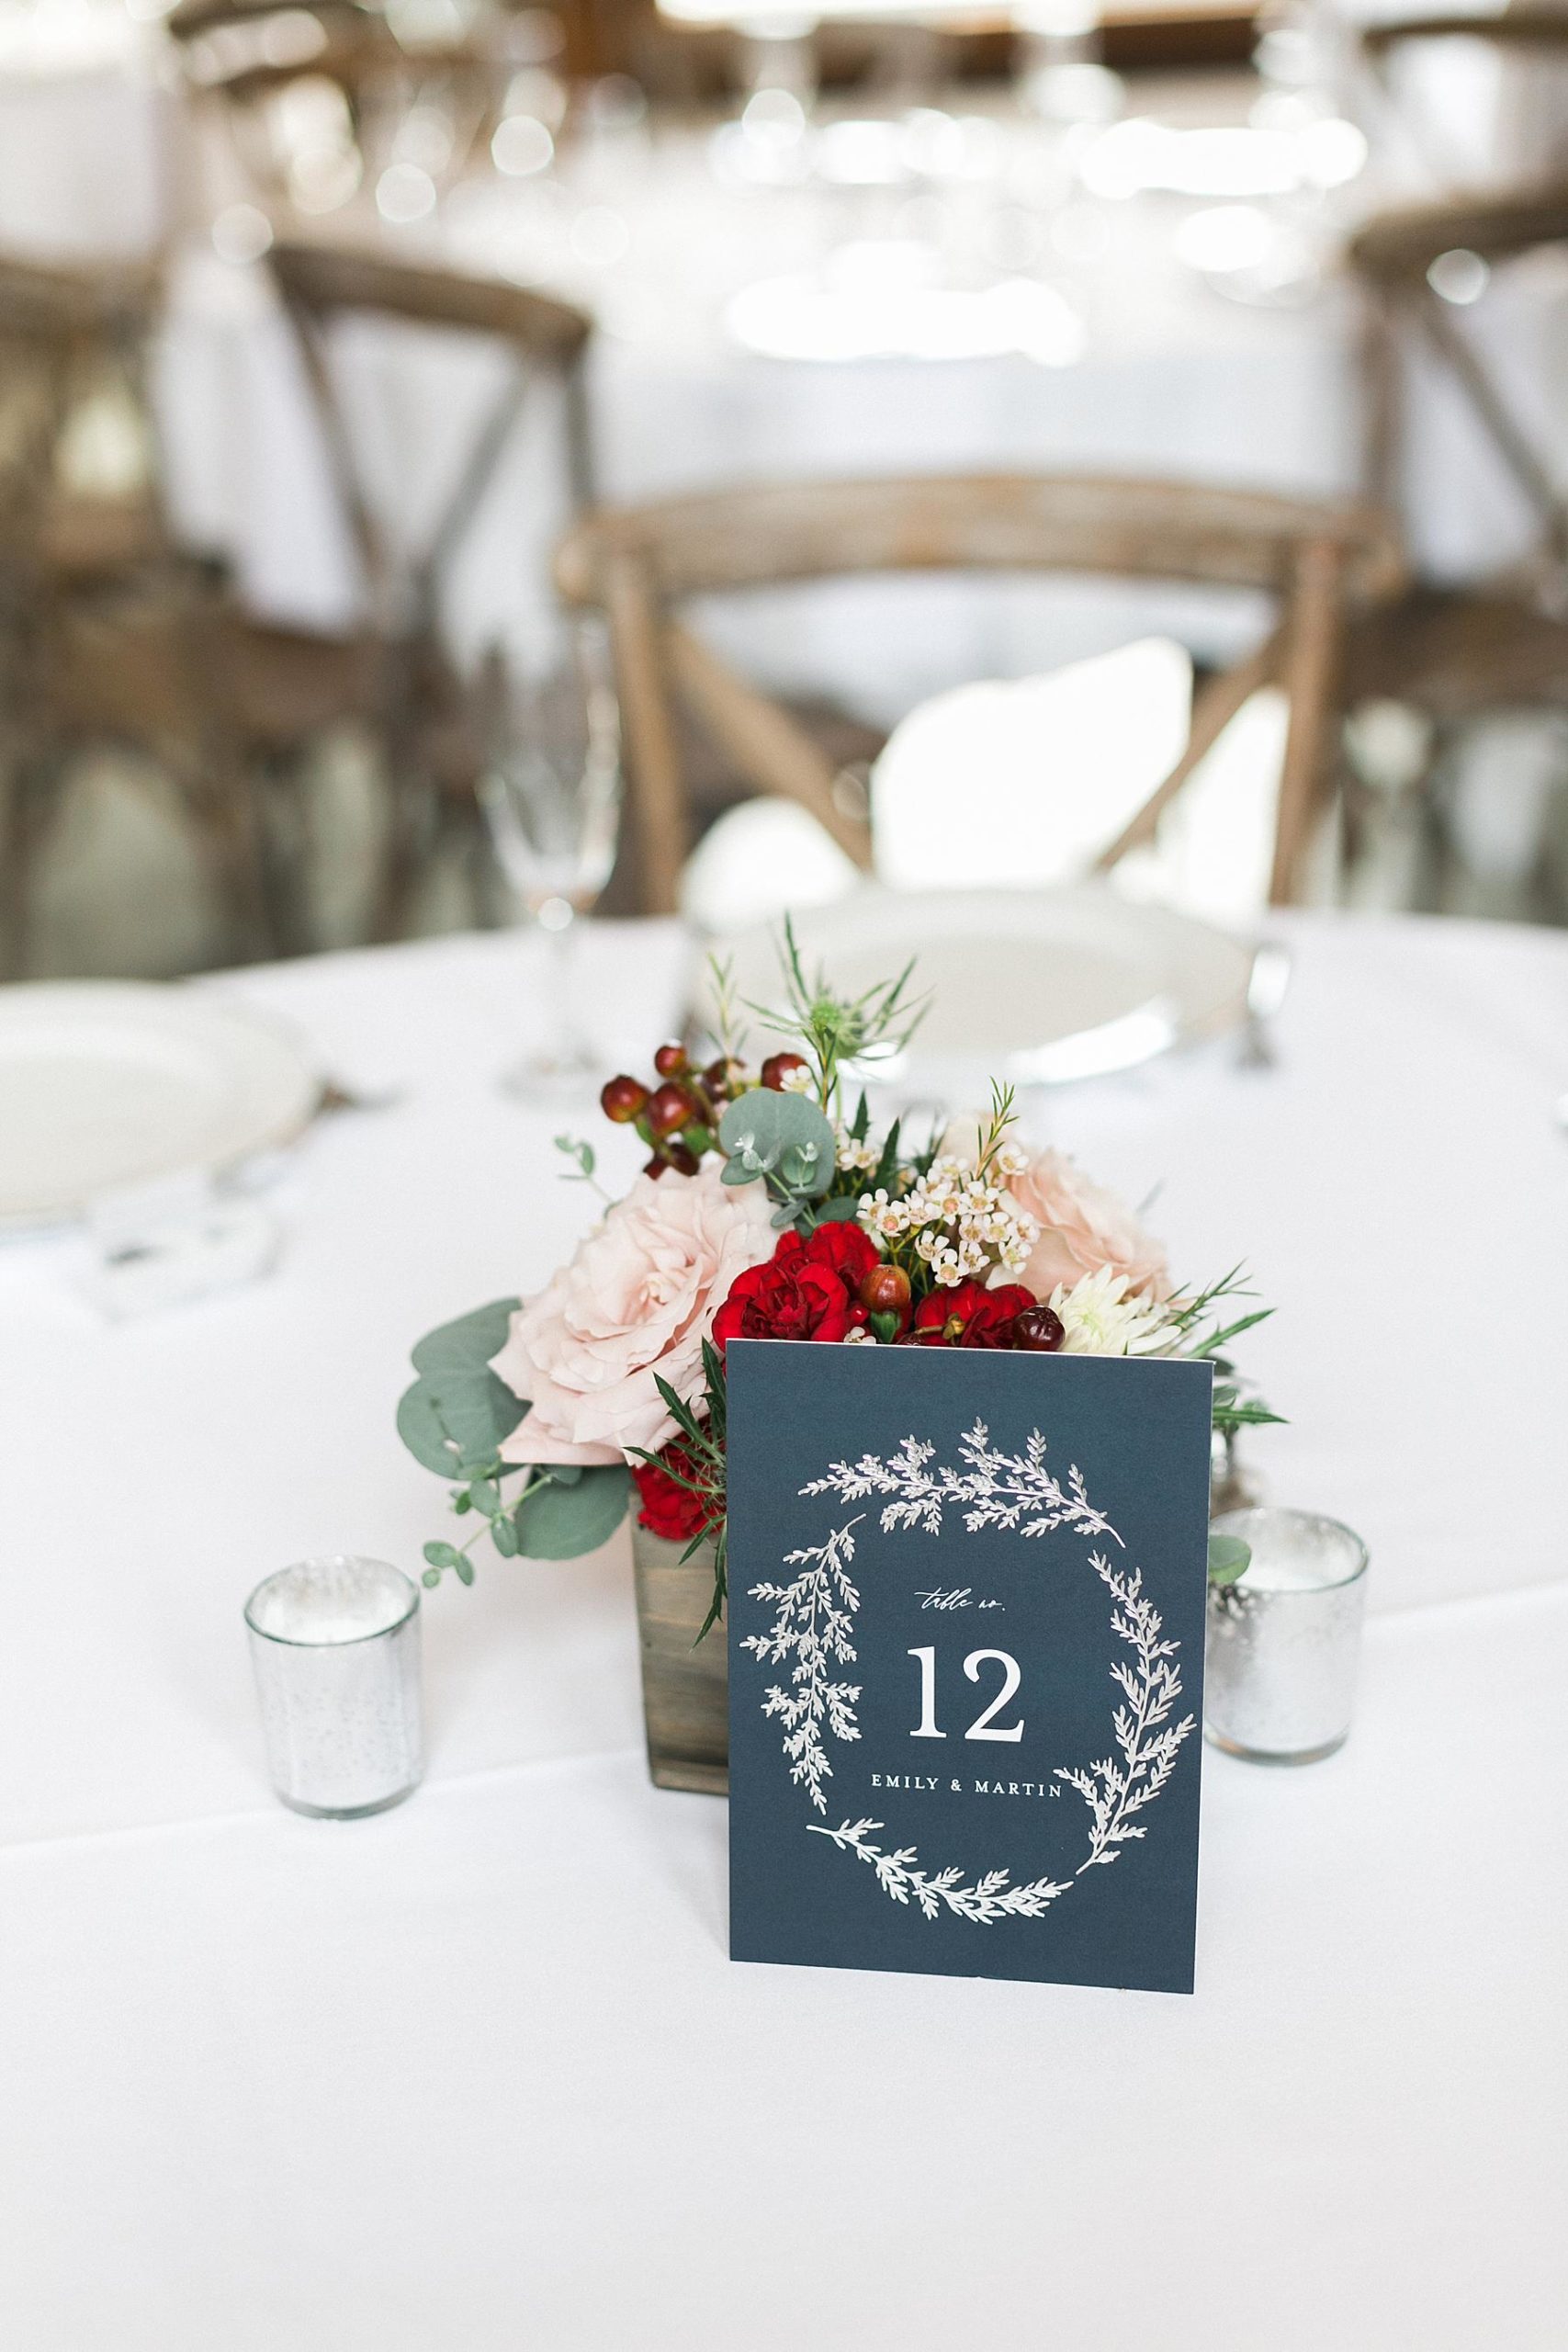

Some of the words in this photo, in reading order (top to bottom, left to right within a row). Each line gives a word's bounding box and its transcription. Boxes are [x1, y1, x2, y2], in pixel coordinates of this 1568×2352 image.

[913, 1587, 974, 1611] table
[977, 1599, 1006, 1611] no.
[907, 1645, 1025, 1743] 12
[871, 1773, 939, 1791] EMILY
[950, 1779, 963, 1792] &
[975, 1780, 1063, 1798] MARTIN
